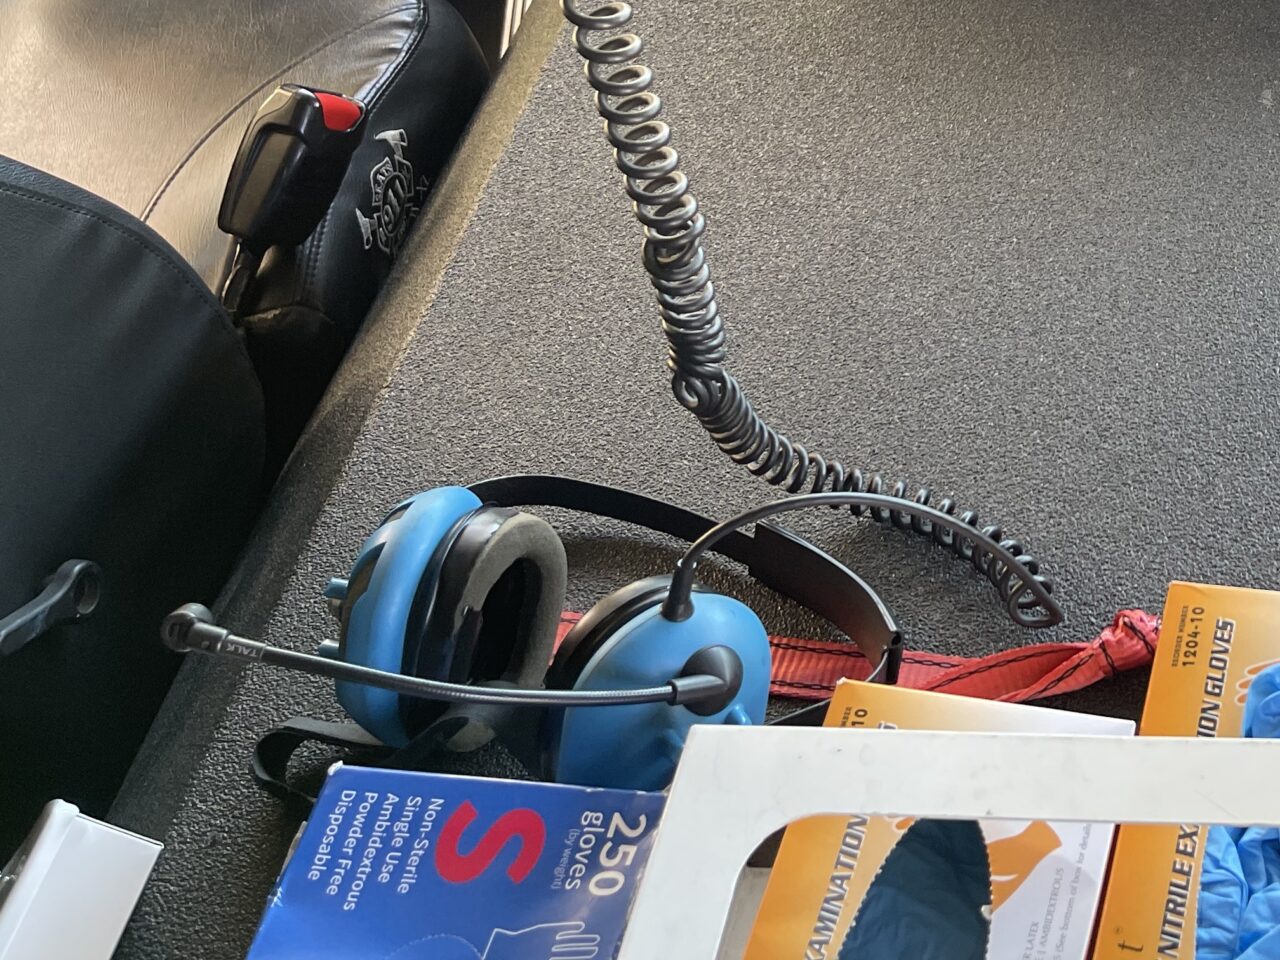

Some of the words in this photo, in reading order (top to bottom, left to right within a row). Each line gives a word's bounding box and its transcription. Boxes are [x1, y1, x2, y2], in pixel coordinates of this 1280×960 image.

[226, 643, 257, 657] TALK
[1182, 606, 1206, 668] 1204-10
[1204, 618, 1236, 698] GLOVES
[307, 789, 355, 881] Disposable
[342, 791, 377, 857] Powder
[343, 792, 399, 911] Ambidextrous
[394, 795, 423, 849] Single
[397, 798, 444, 894] Non-Sterile
[434, 800, 547, 884] S
[564, 810, 593, 891] gloves
[588, 813, 647, 897] 250
[326, 856, 352, 896] Free
[378, 852, 400, 884] Use
[1040, 867, 1064, 947] AMBIDEXTROUS
[1157, 858, 1194, 958] NITRILE
[1026, 921, 1040, 951] LATEX
[1062, 898, 1075, 930] bottom
